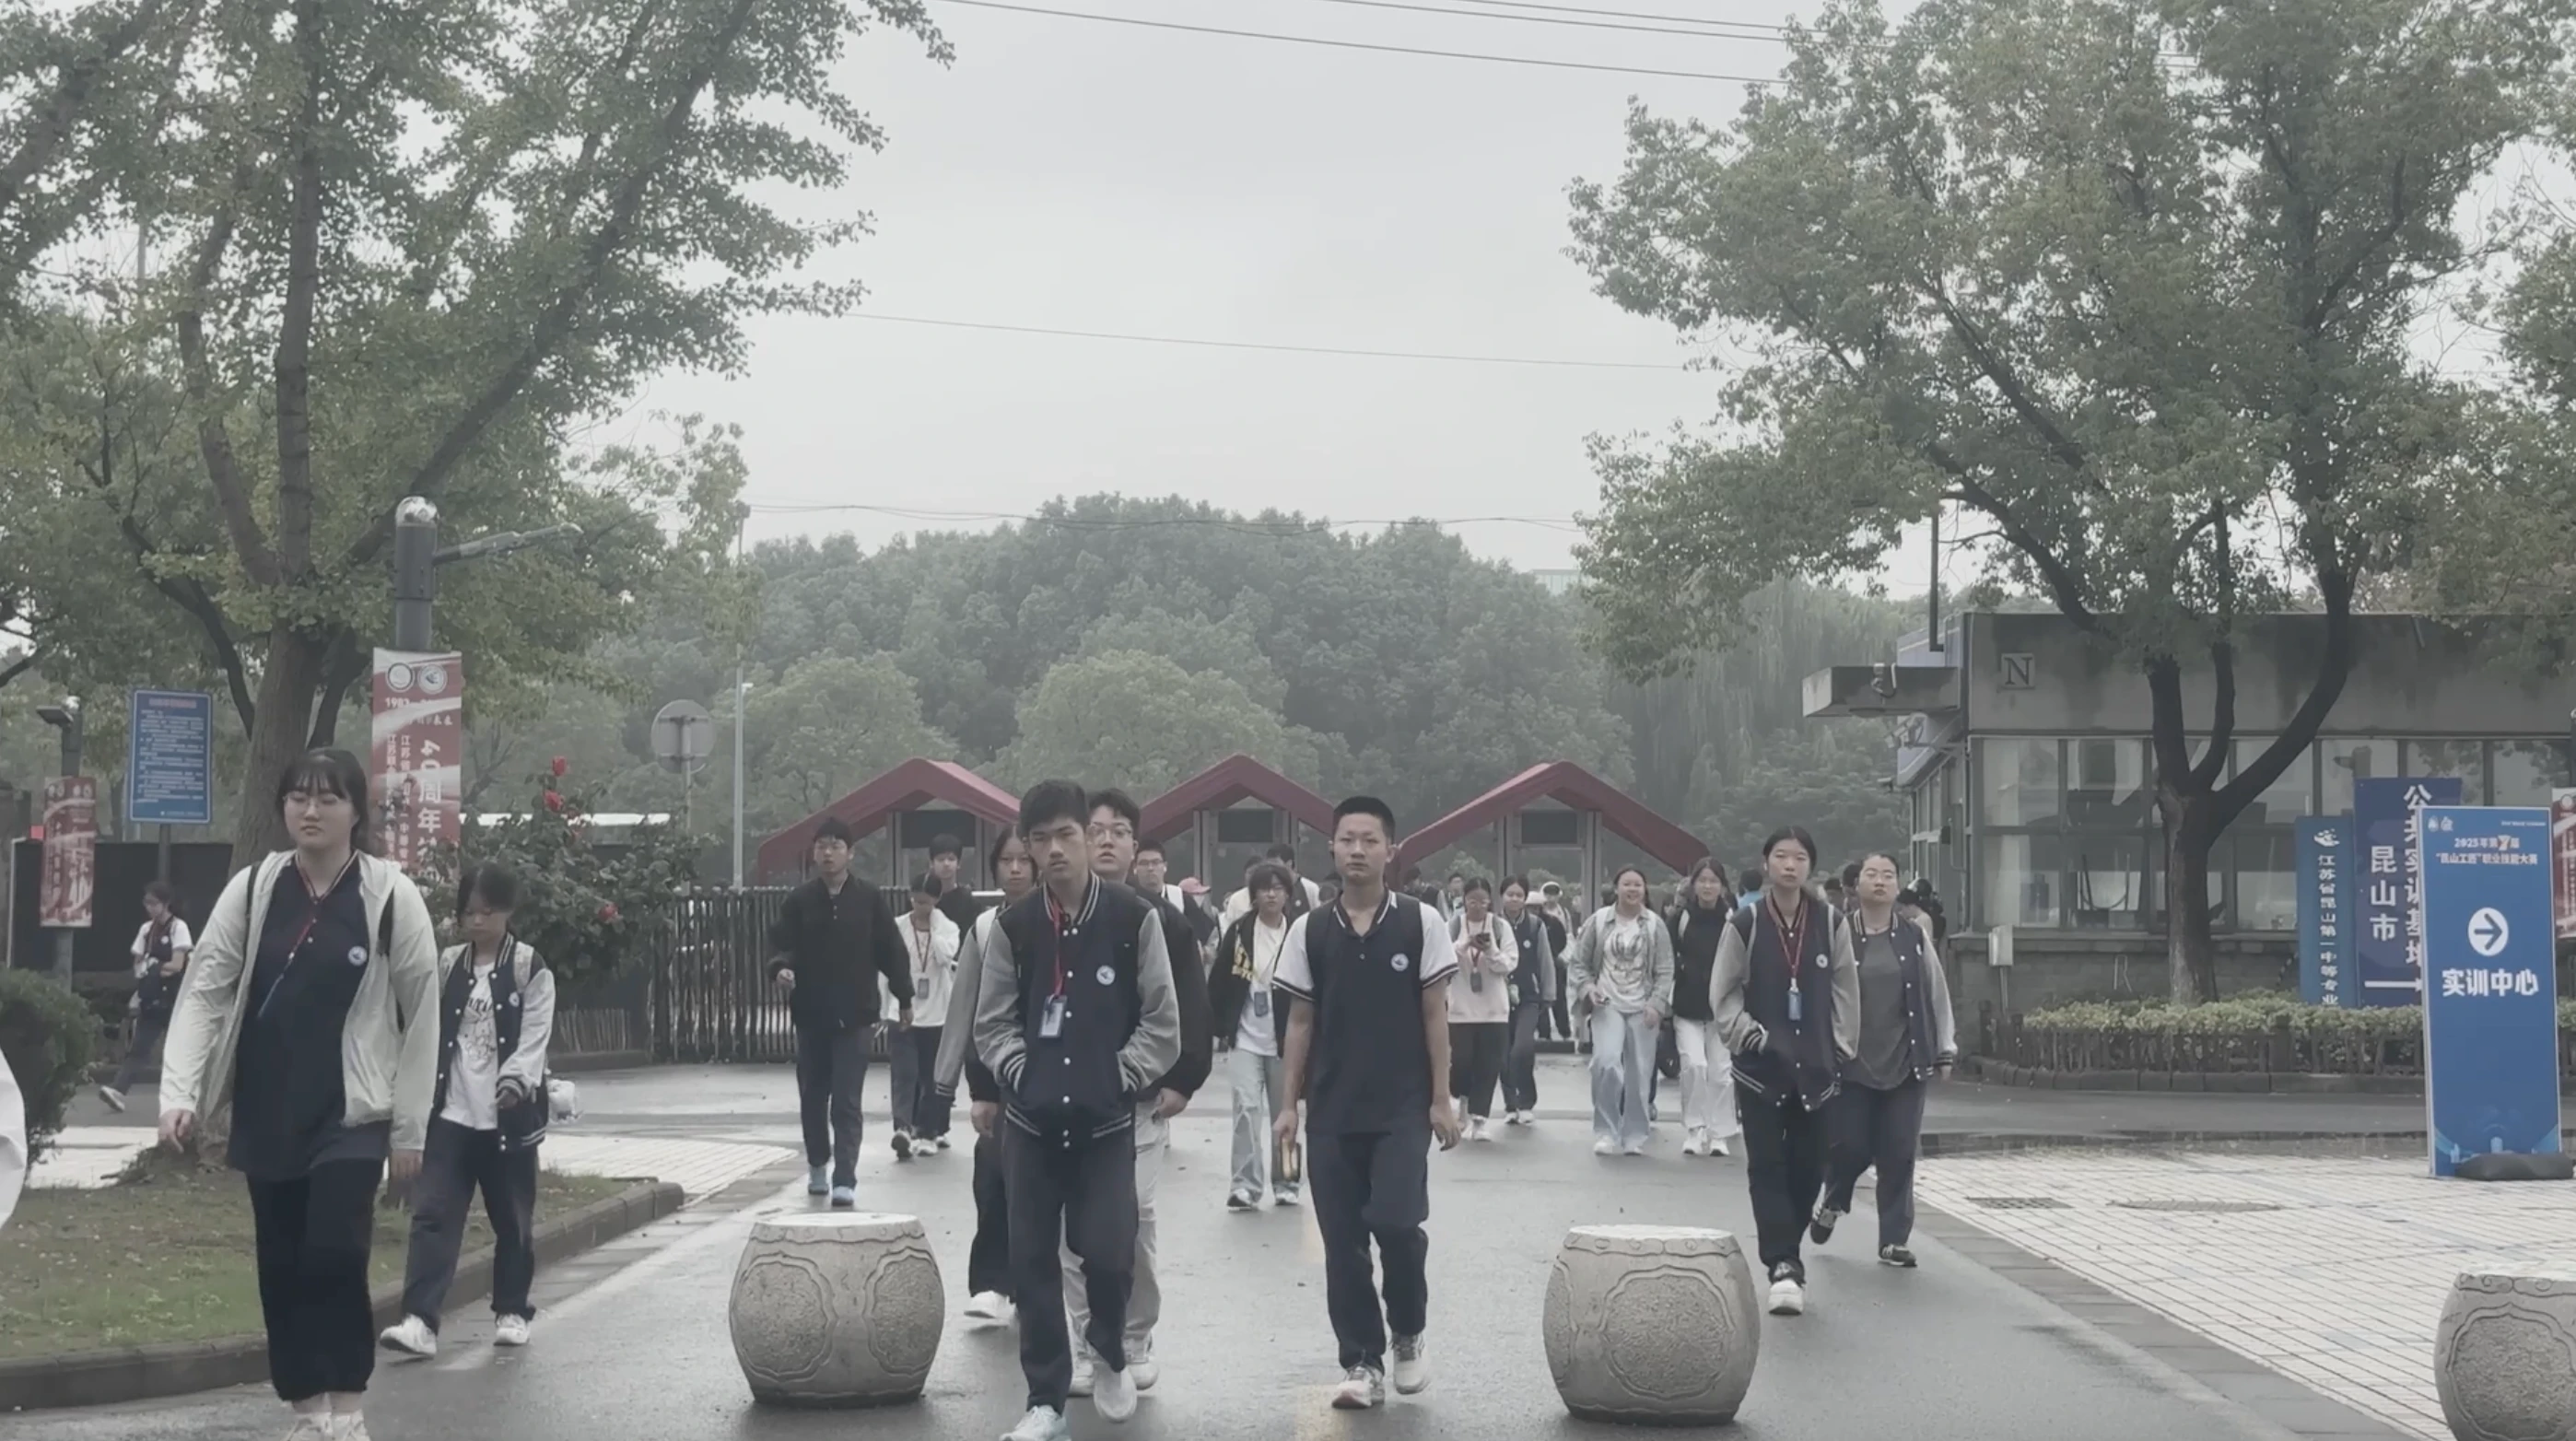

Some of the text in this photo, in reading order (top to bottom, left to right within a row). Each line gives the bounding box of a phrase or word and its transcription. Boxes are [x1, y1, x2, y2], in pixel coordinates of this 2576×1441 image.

[2004, 656, 2033, 685] N
[2370, 845, 2398, 942] 昆山市
[2441, 967, 2540, 997] 实训中心
